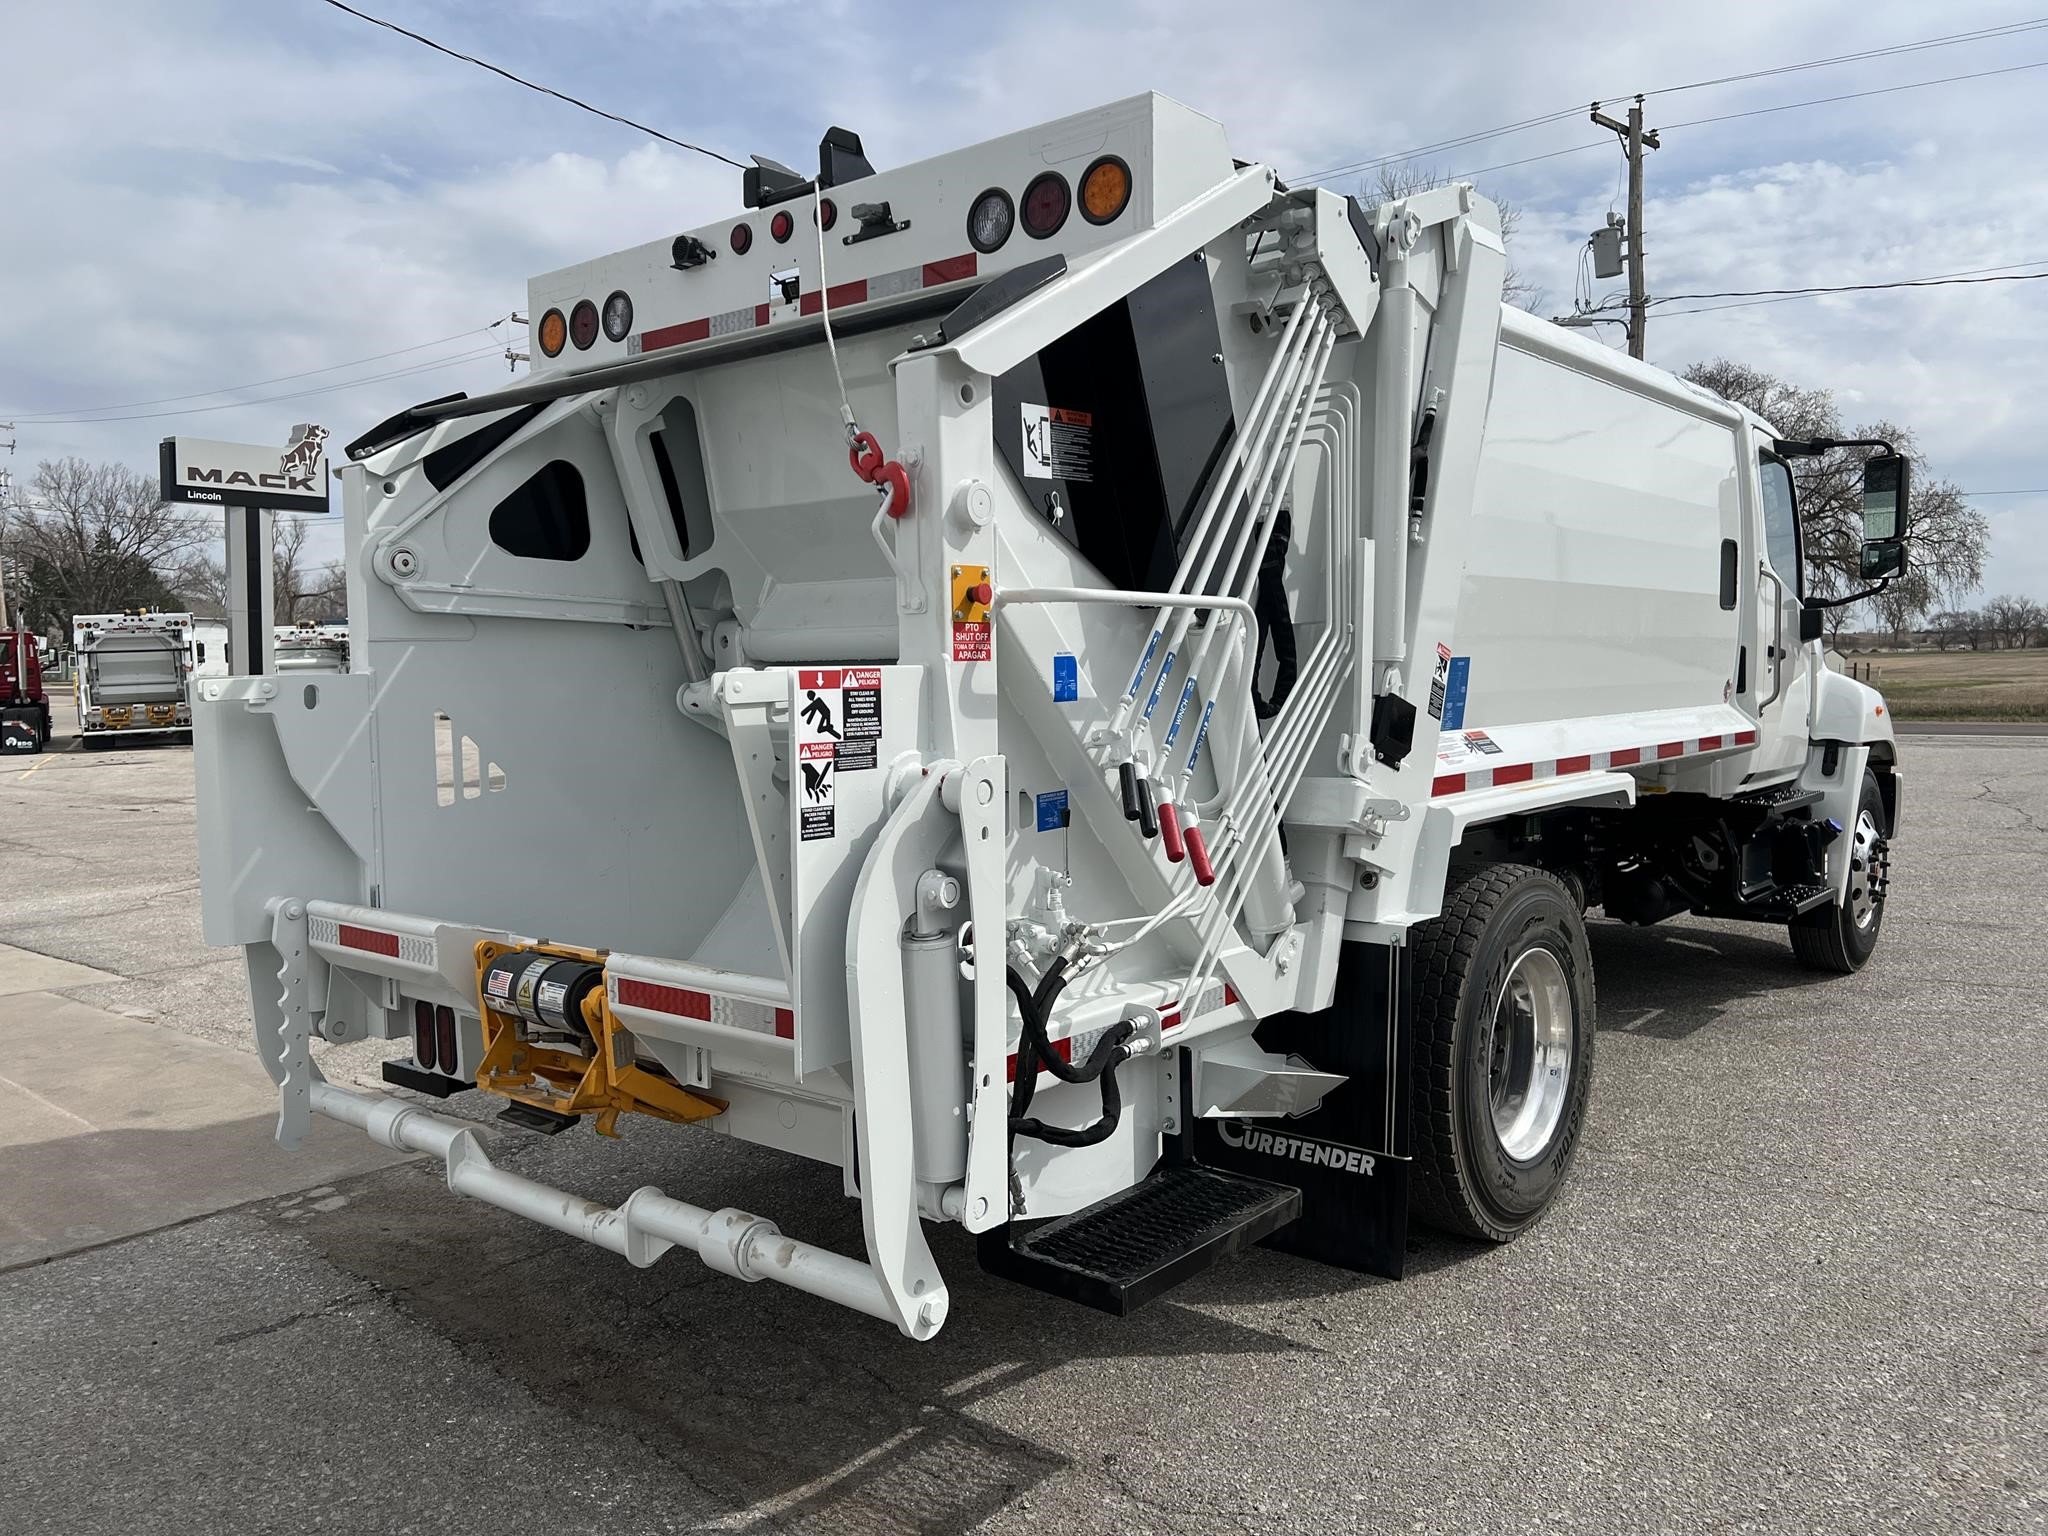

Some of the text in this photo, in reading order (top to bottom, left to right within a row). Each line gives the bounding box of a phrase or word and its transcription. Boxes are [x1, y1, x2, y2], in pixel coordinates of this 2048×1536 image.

[188, 467, 316, 491] MACK
[188, 490, 222, 501] Lincoln
[965, 623, 980, 632] PTO
[955, 633, 989, 641] SHUT OFF
[958, 650, 987, 659] APAGAR
[856, 671, 881, 679] DANGER
[1155, 672, 1168, 696] SWEEP
[1175, 698, 1189, 726] WINCH
[810, 743, 834, 751] DANGER
[811, 750, 833, 758] PELIGRO
[1217, 1117, 1376, 1176] CURBTENDER
